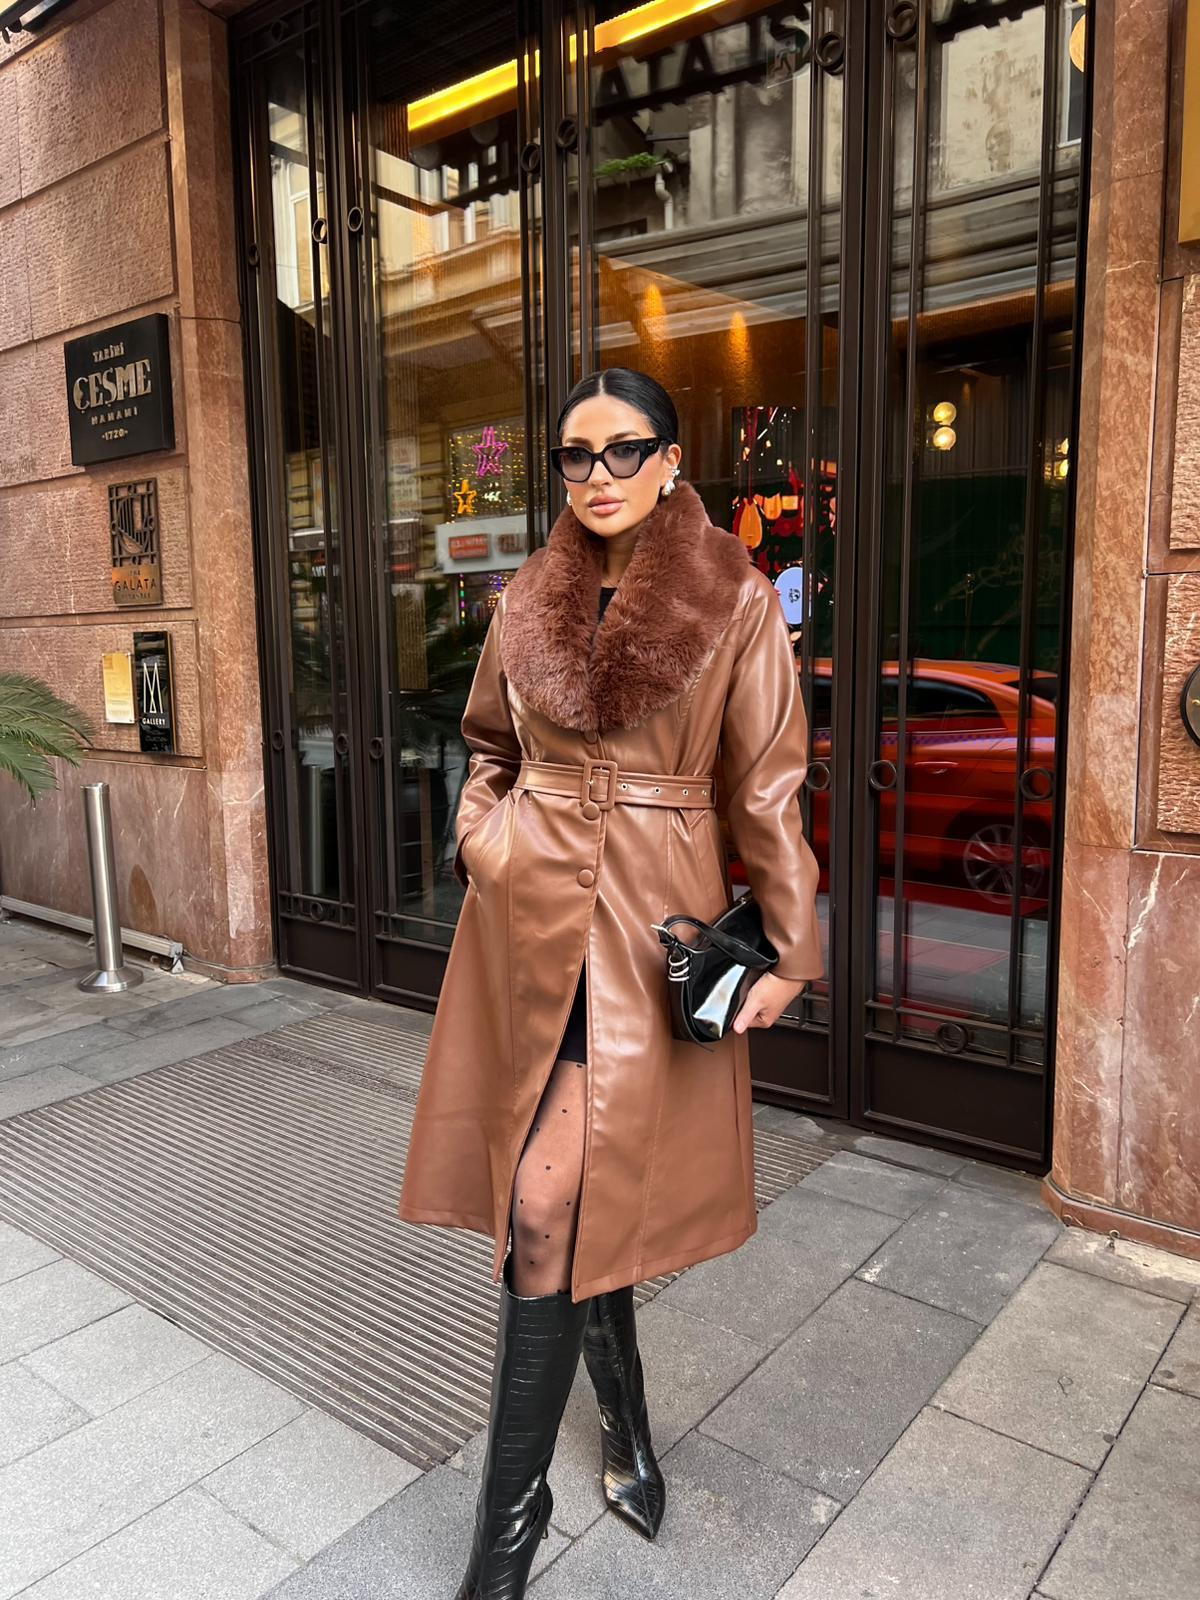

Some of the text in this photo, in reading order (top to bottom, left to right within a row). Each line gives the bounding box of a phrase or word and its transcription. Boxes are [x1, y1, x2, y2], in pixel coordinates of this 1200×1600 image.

[73, 358, 152, 414] ÇEŞME
[114, 578, 157, 592] GALATA
[142, 717, 166, 726] GALLERY
